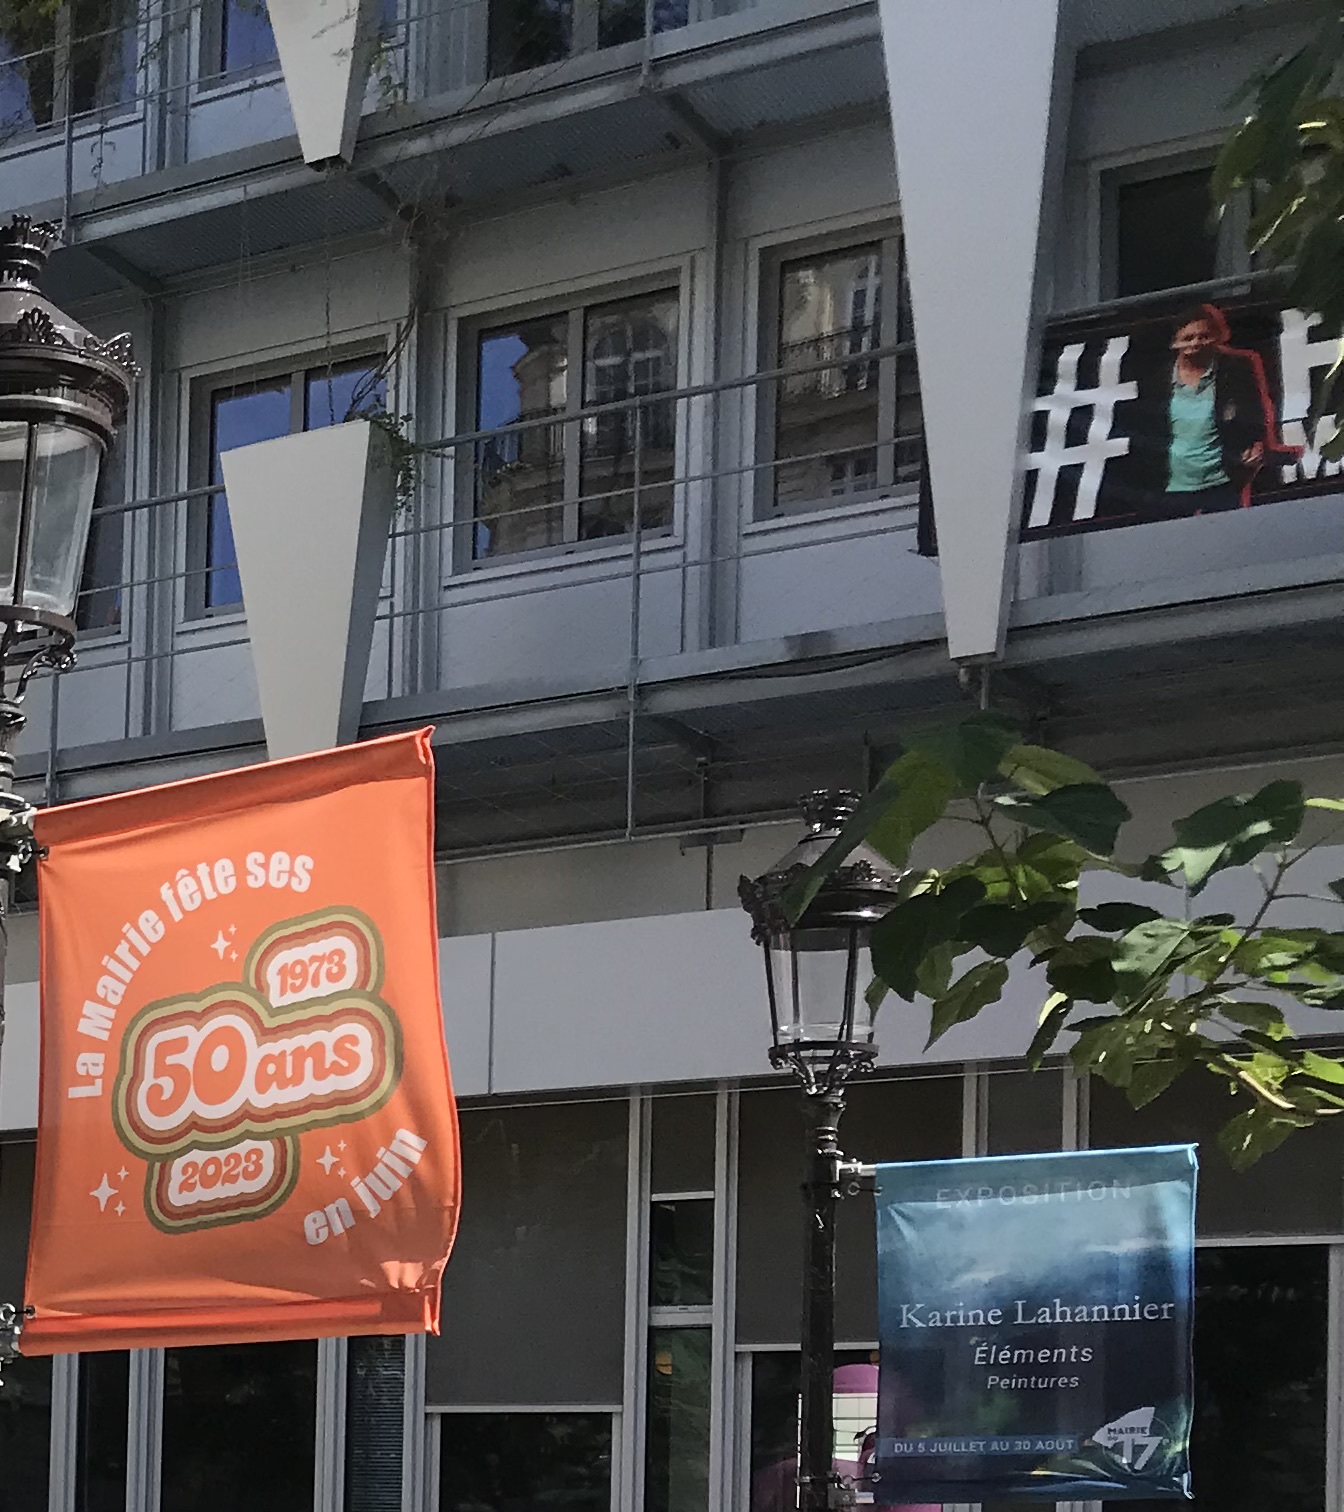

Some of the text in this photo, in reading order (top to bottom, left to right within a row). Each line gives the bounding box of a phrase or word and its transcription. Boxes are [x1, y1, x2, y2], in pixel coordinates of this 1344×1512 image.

[68, 851, 314, 1099] La Mairie fête ses
[276, 948, 347, 998] 1973
[178, 1147, 265, 1195] 2023
[304, 1128, 428, 1245] en juin
[936, 1178, 1131, 1209] EXPOSITION
[899, 1295, 1175, 1329] Karine Lahannier
[974, 1342, 1094, 1366] Éléments
[987, 1375, 1080, 1389] Peintures
[894, 1443, 913, 1454] DU
[918, 1442, 926, 1453] 5
[929, 1440, 986, 1453] JUILLET
[991, 1441, 1009, 1452] AU
[1015, 1440, 1031, 1451] 30
[1107, 1426, 1148, 1436] MAIRIE
